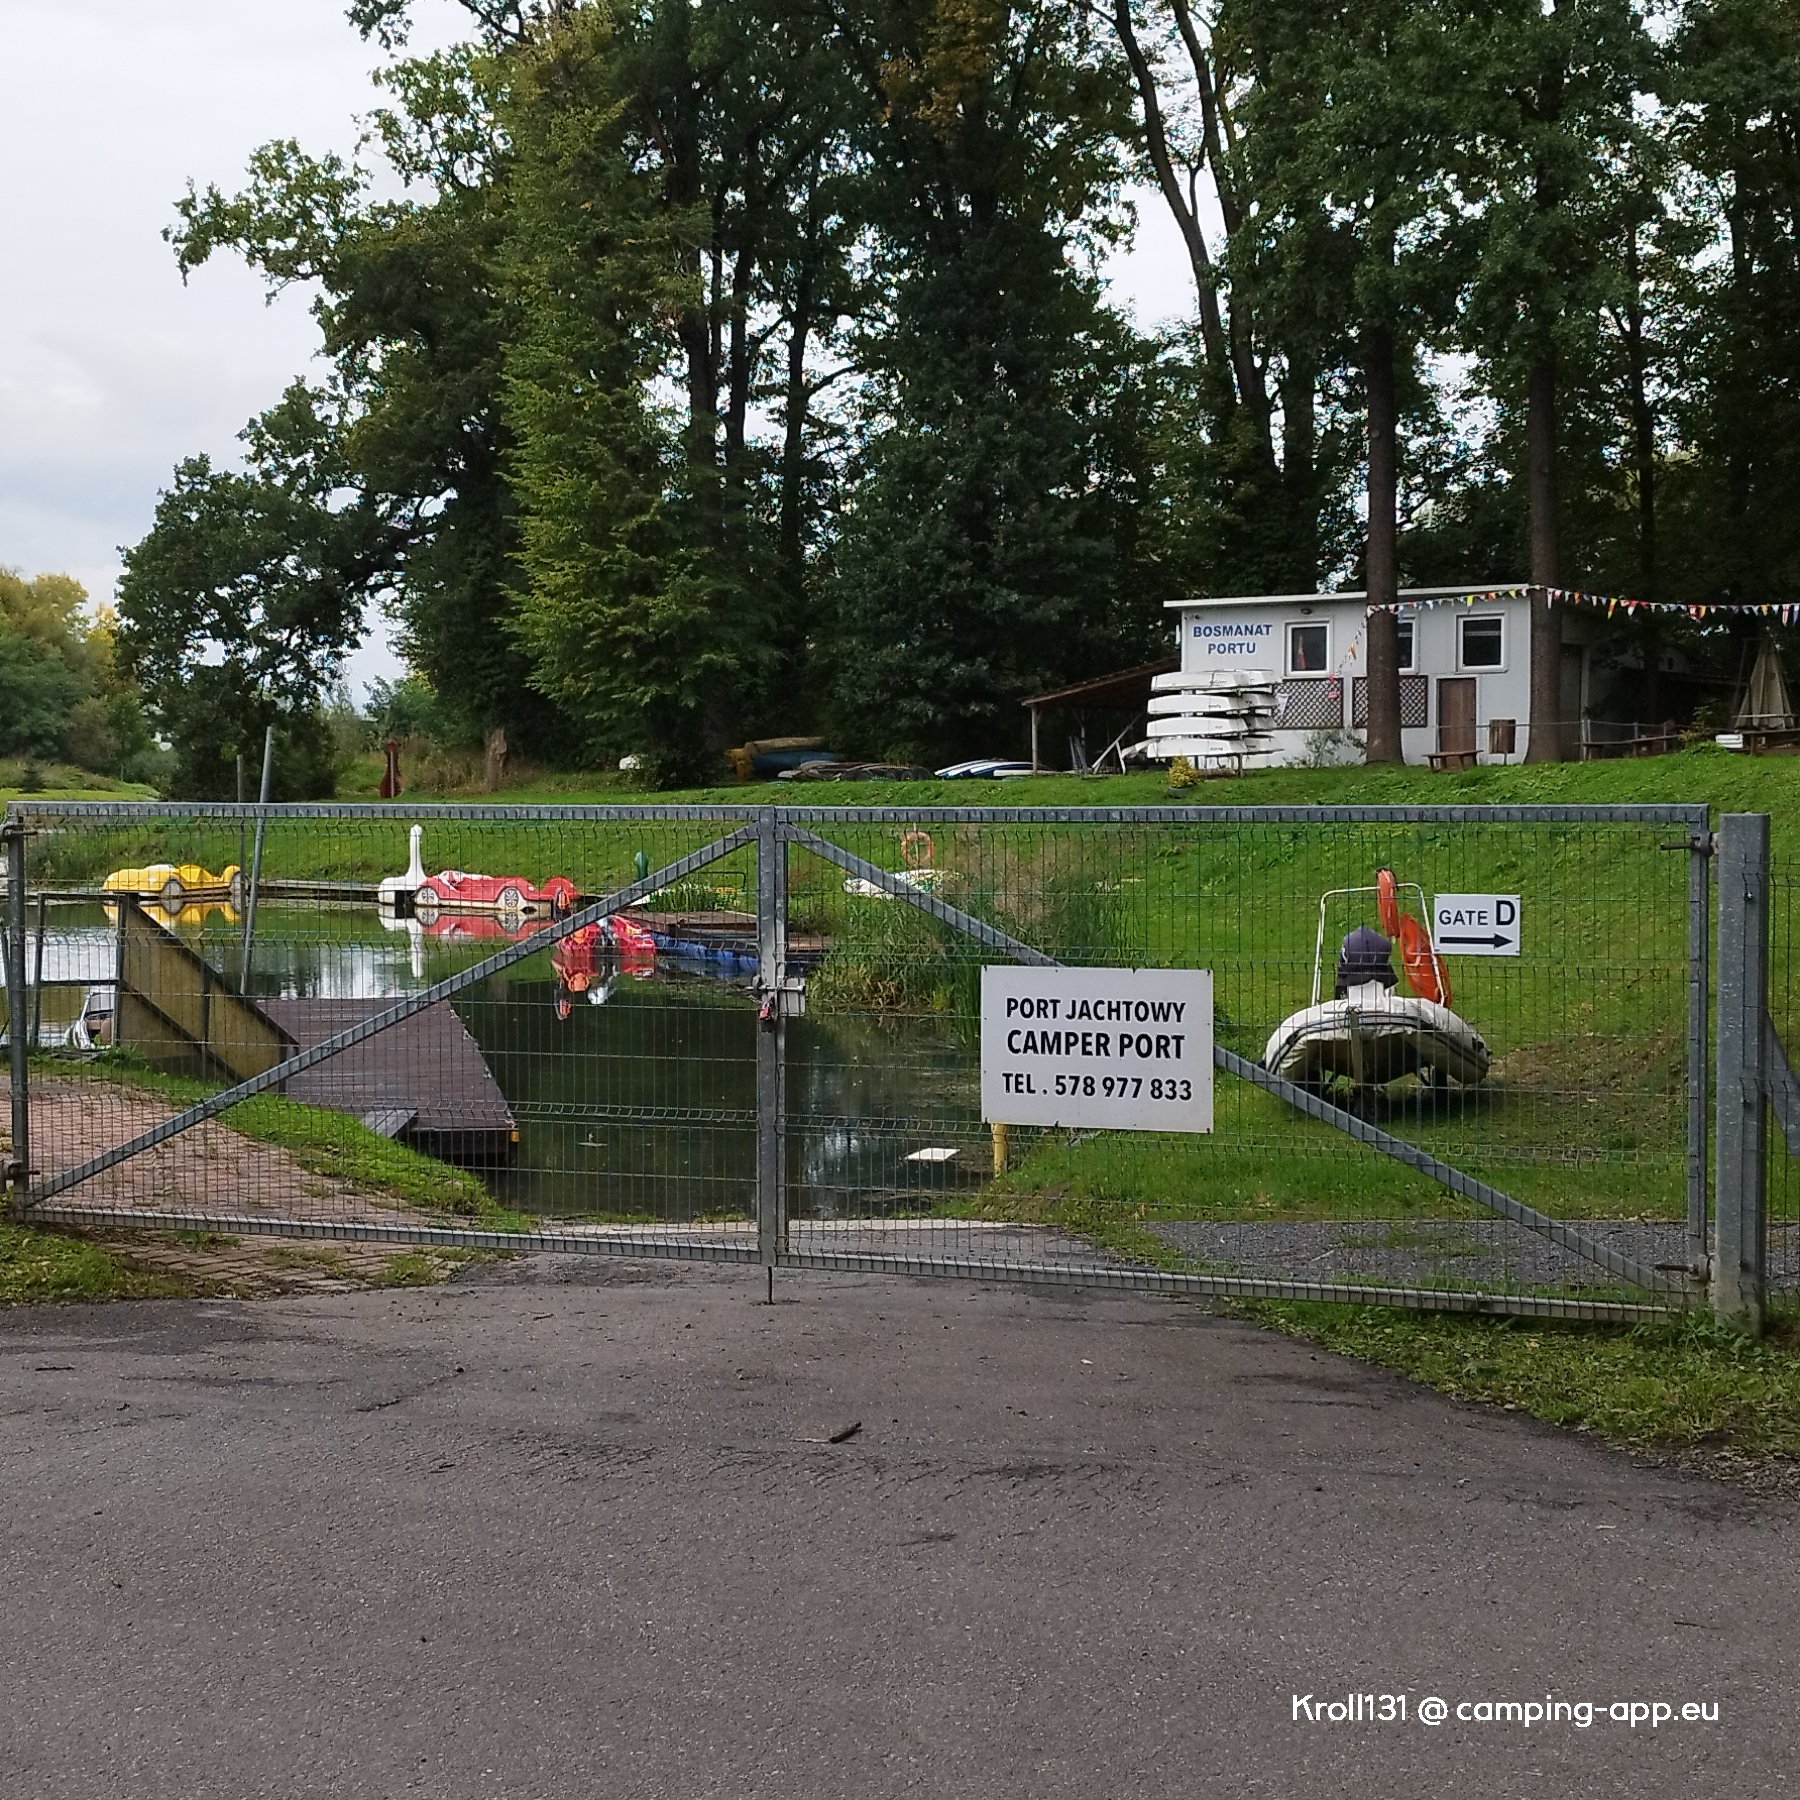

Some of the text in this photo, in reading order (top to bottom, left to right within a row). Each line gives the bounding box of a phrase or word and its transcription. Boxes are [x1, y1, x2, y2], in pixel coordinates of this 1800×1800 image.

[1193, 624, 1273, 638] BOSMANAT
[1207, 642, 1256, 655] PORTU
[1438, 899, 1516, 926] GATE D
[1006, 997, 1187, 1023] PORT JACHTOWY
[1007, 1029, 1186, 1060] CAMPER PORT
[1055, 1074, 1096, 1097] 578
[1101, 1076, 1143, 1099] 977
[1149, 1078, 1192, 1101] 833
